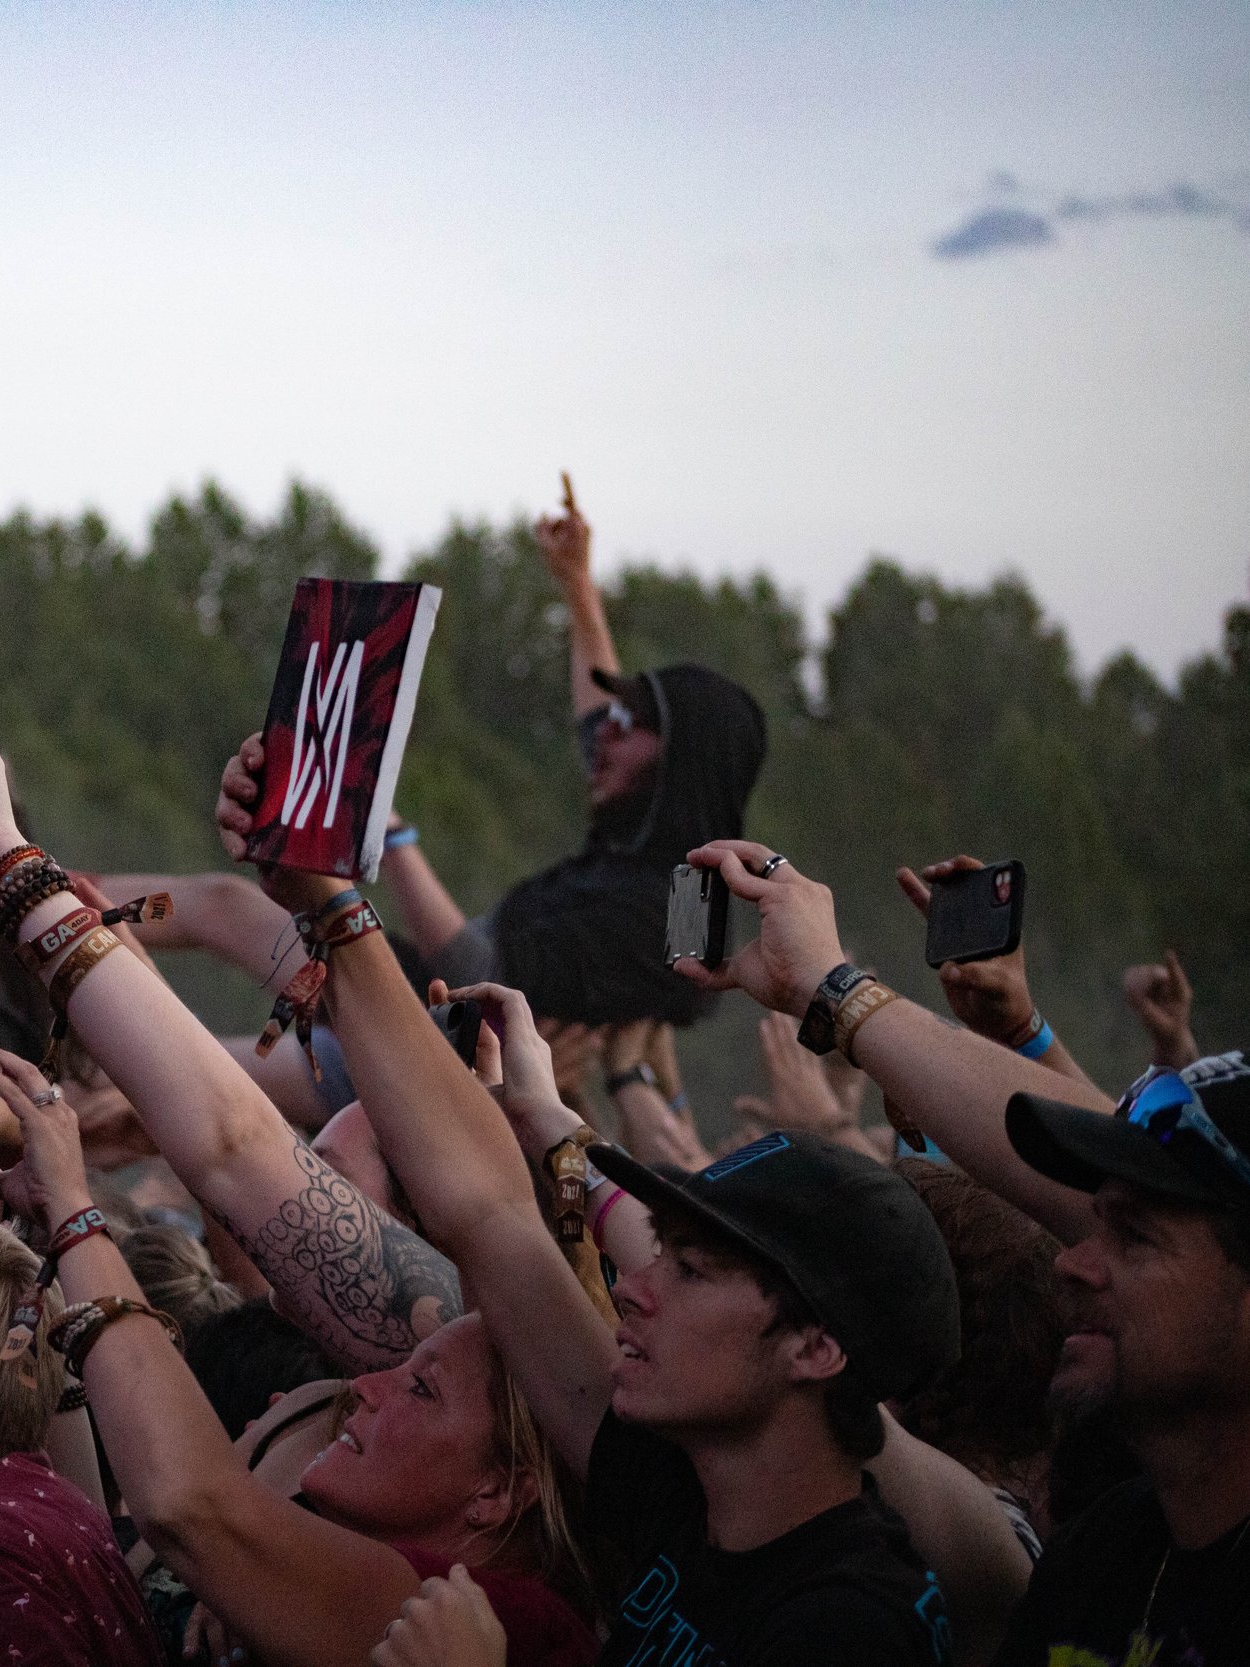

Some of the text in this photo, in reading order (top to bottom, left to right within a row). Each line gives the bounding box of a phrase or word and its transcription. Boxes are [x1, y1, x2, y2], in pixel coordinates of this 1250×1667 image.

[40, 914, 90, 953] GA 4DAY
[344, 908, 377, 934] GA
[561, 1184, 580, 1201] 2021
[65, 1208, 106, 1235] GA
